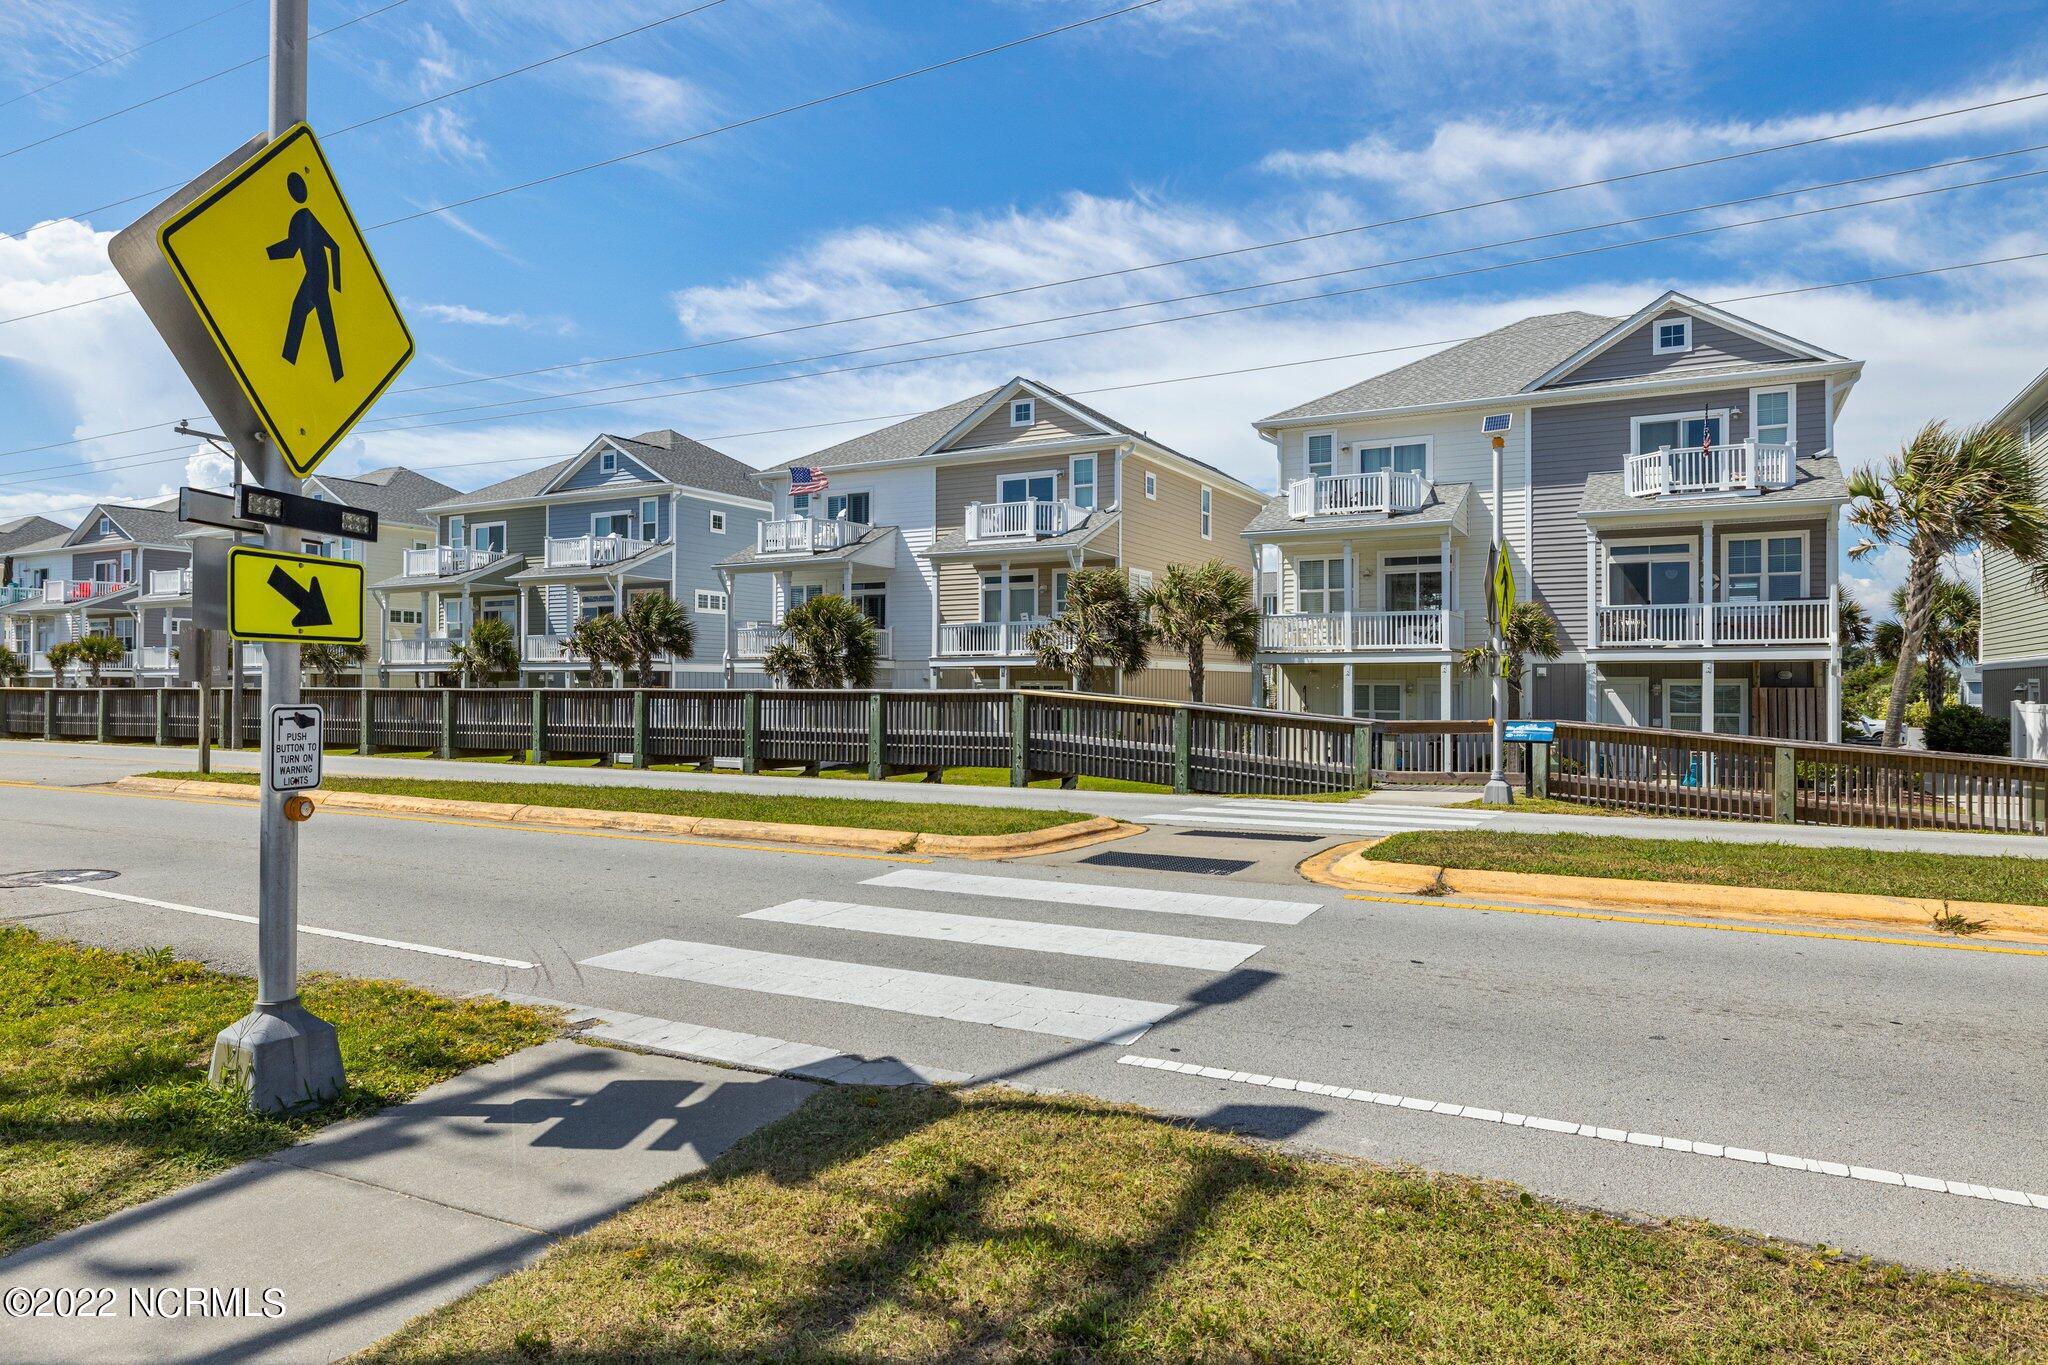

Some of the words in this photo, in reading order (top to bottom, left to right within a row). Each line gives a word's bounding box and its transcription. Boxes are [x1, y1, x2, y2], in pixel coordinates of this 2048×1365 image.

[287, 733, 306, 741] PUSH
[276, 743, 305, 753] BUTTON
[308, 743, 317, 751] TO
[280, 755, 299, 764] TURN
[303, 754, 313, 762] ON
[280, 765, 312, 775] WARNING
